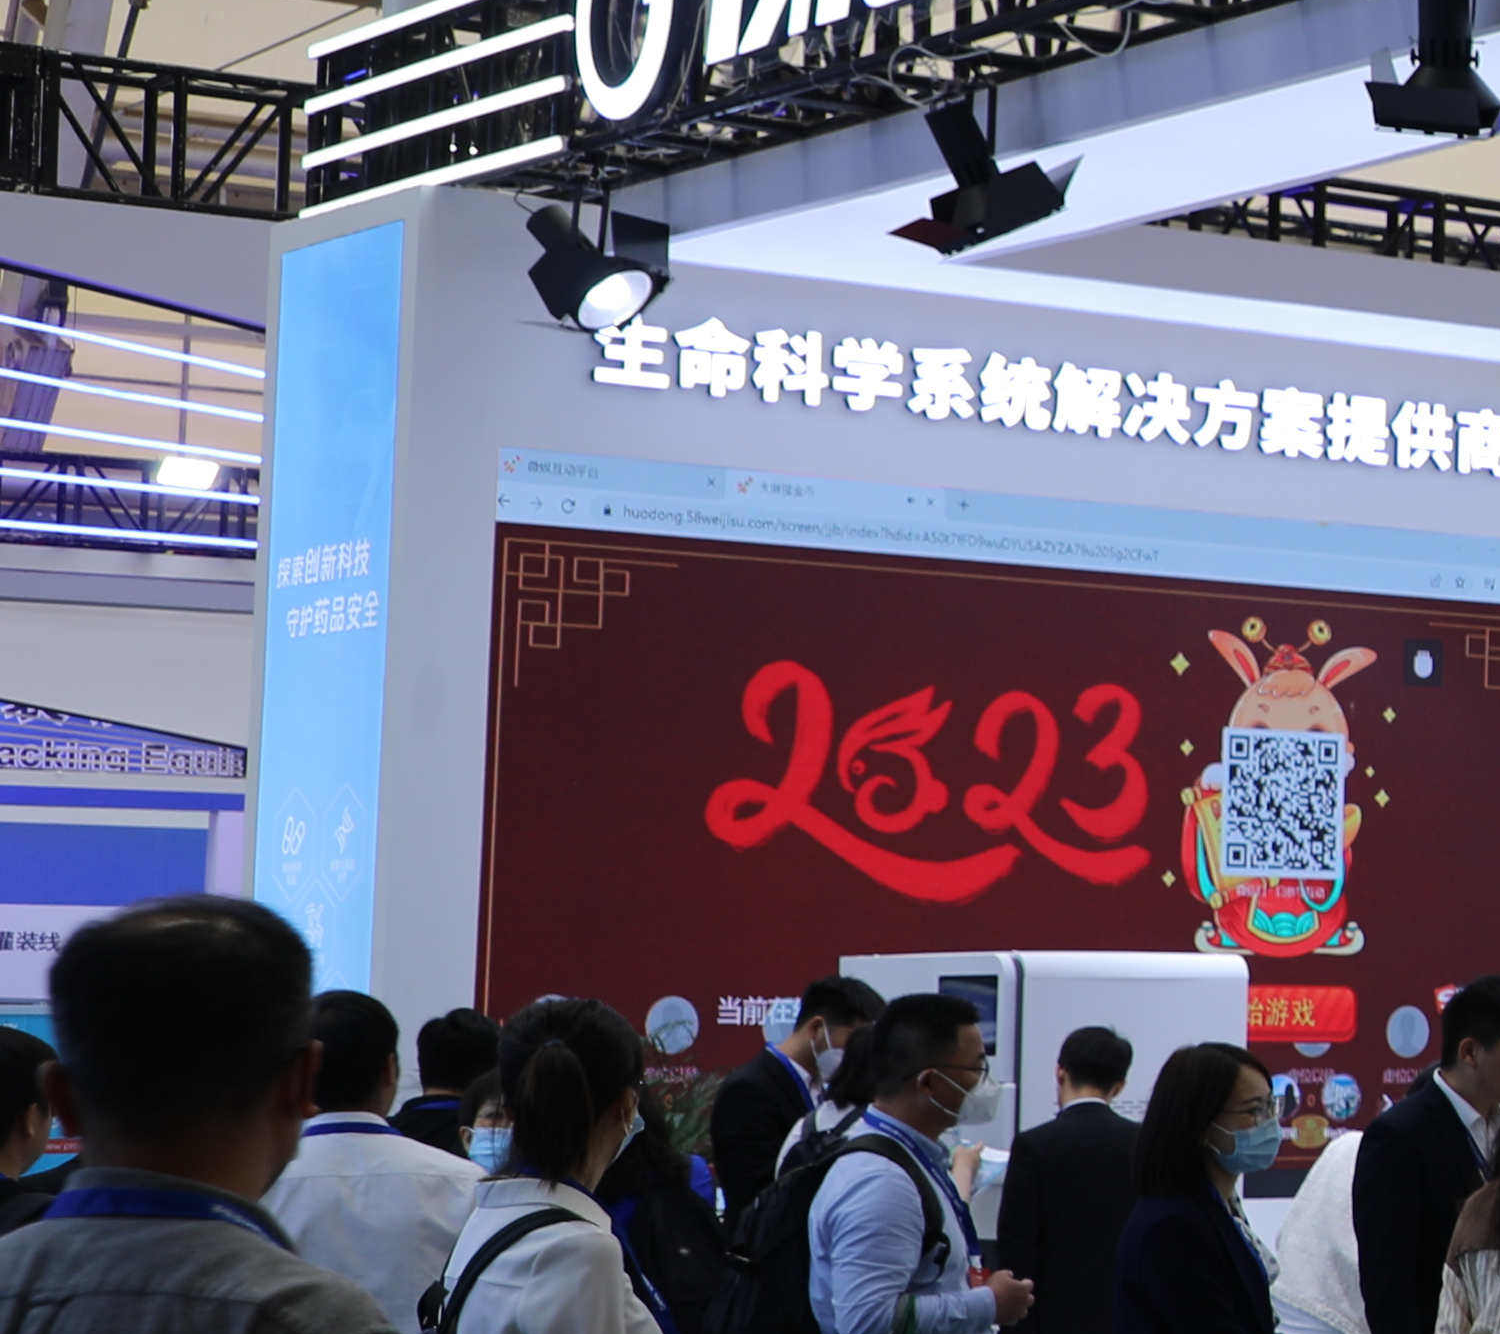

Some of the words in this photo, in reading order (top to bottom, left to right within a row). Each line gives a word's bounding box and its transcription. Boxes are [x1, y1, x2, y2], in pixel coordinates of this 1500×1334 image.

[276, 540, 370, 590] 探索创新科技
[284, 591, 380, 640] 守护药品安全
